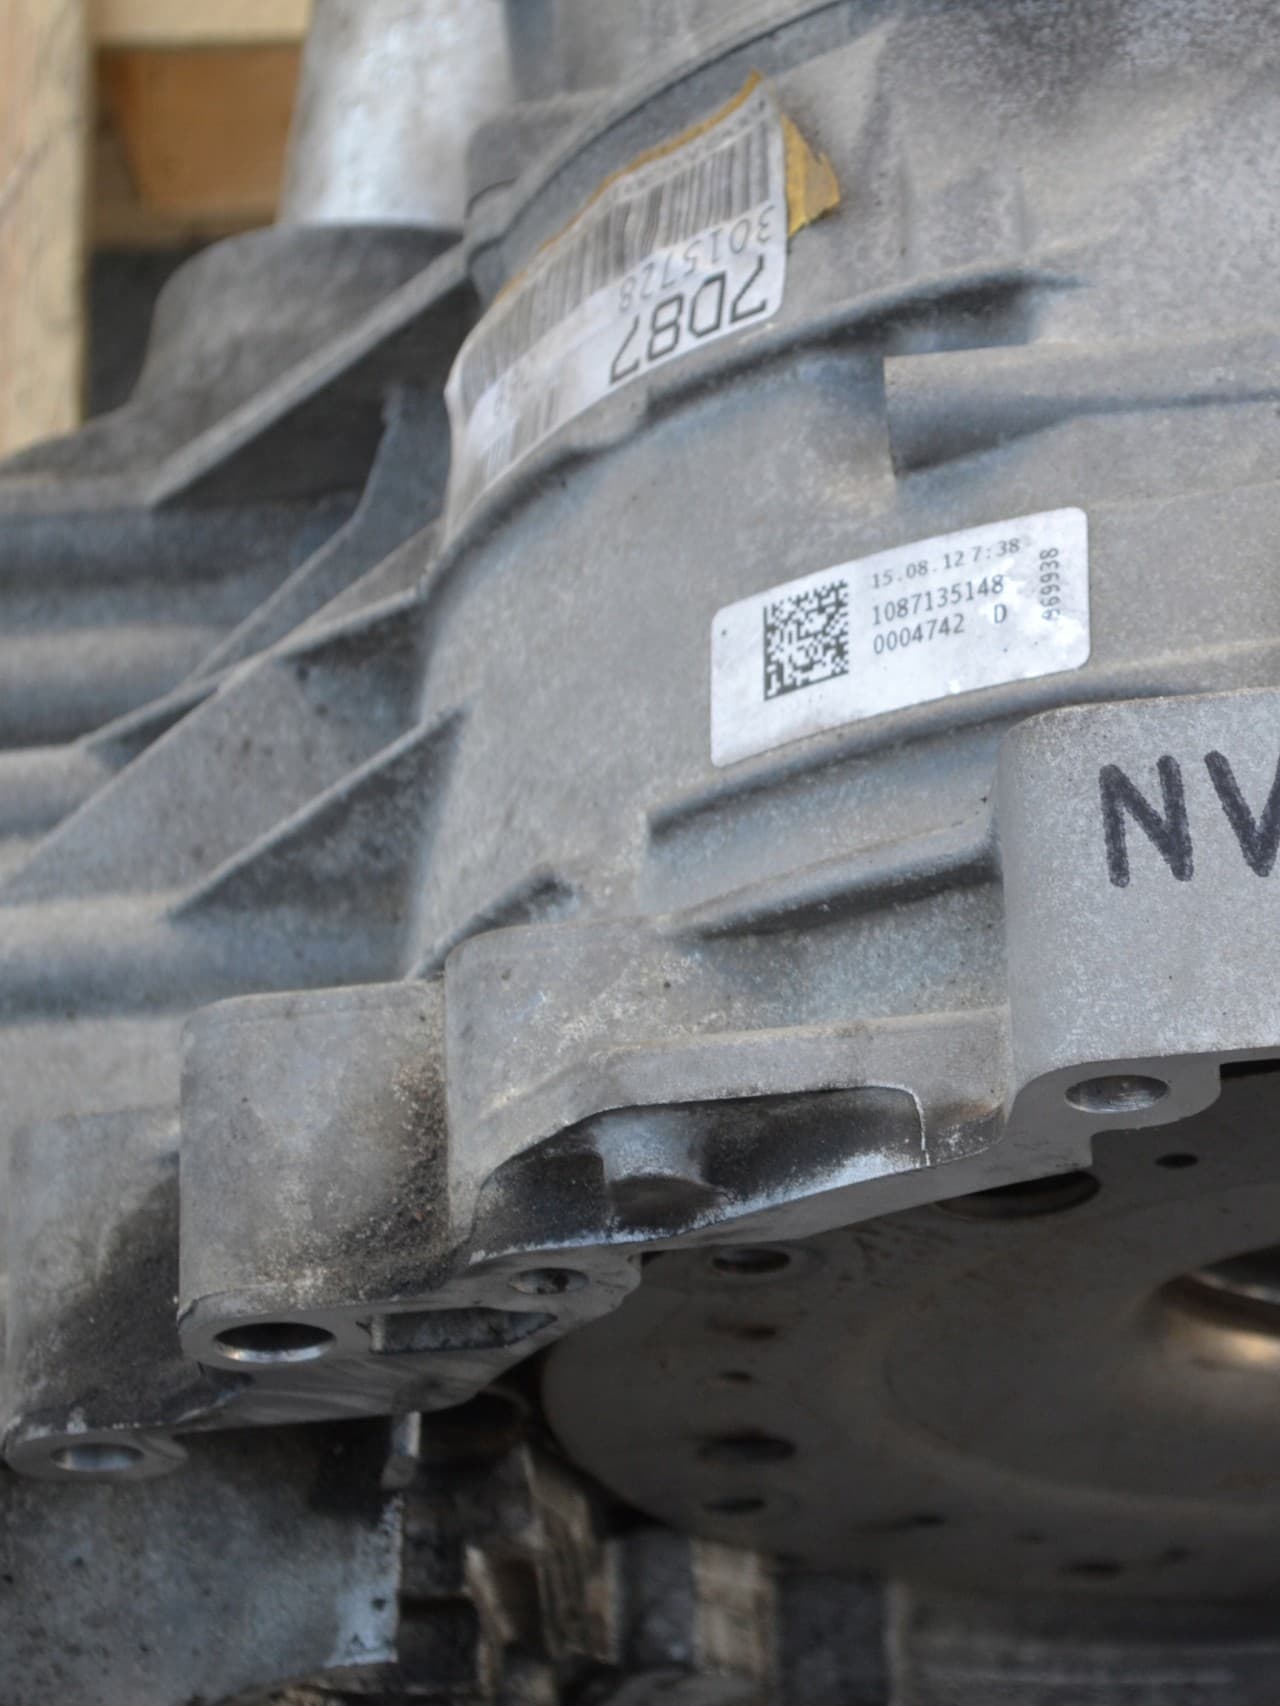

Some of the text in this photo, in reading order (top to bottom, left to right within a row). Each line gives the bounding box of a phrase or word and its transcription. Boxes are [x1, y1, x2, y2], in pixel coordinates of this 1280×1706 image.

[872, 537, 1021, 590] 15.08.12 7:38
[872, 573, 1005, 626] 1087135148
[873, 603, 1008, 655] 0004742 D
